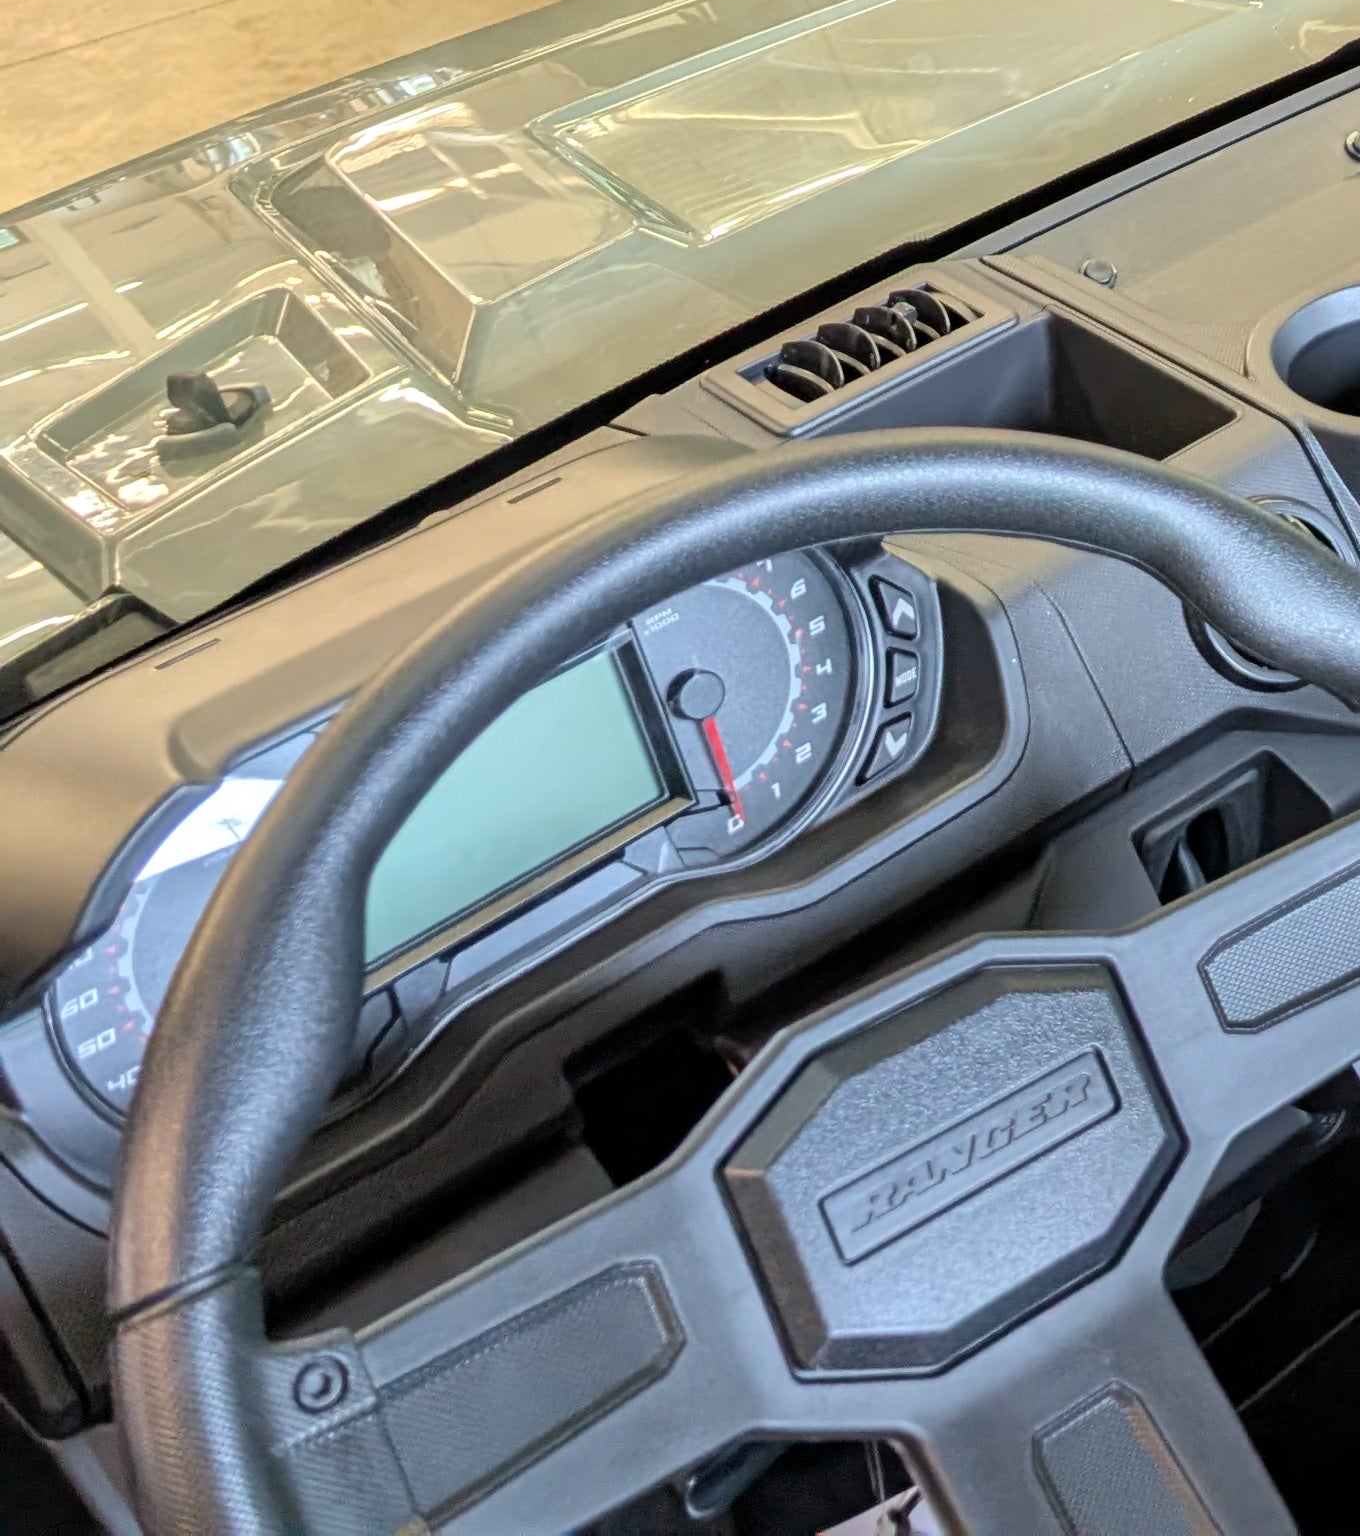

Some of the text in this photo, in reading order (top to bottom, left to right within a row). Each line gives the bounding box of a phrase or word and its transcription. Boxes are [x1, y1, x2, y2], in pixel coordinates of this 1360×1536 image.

[790, 578, 807, 600] 6
[645, 607, 674, 625] RPM
[808, 615, 826, 636] 5
[815, 658, 833, 676] 4
[894, 666, 918, 688] MODE
[811, 702, 828, 724] 3
[795, 742, 812, 763] 2
[770, 781, 781, 799] 1
[727, 813, 745, 834] 0
[77, 1027, 116, 1059] 50
[851, 1072, 1092, 1234] RANGER
